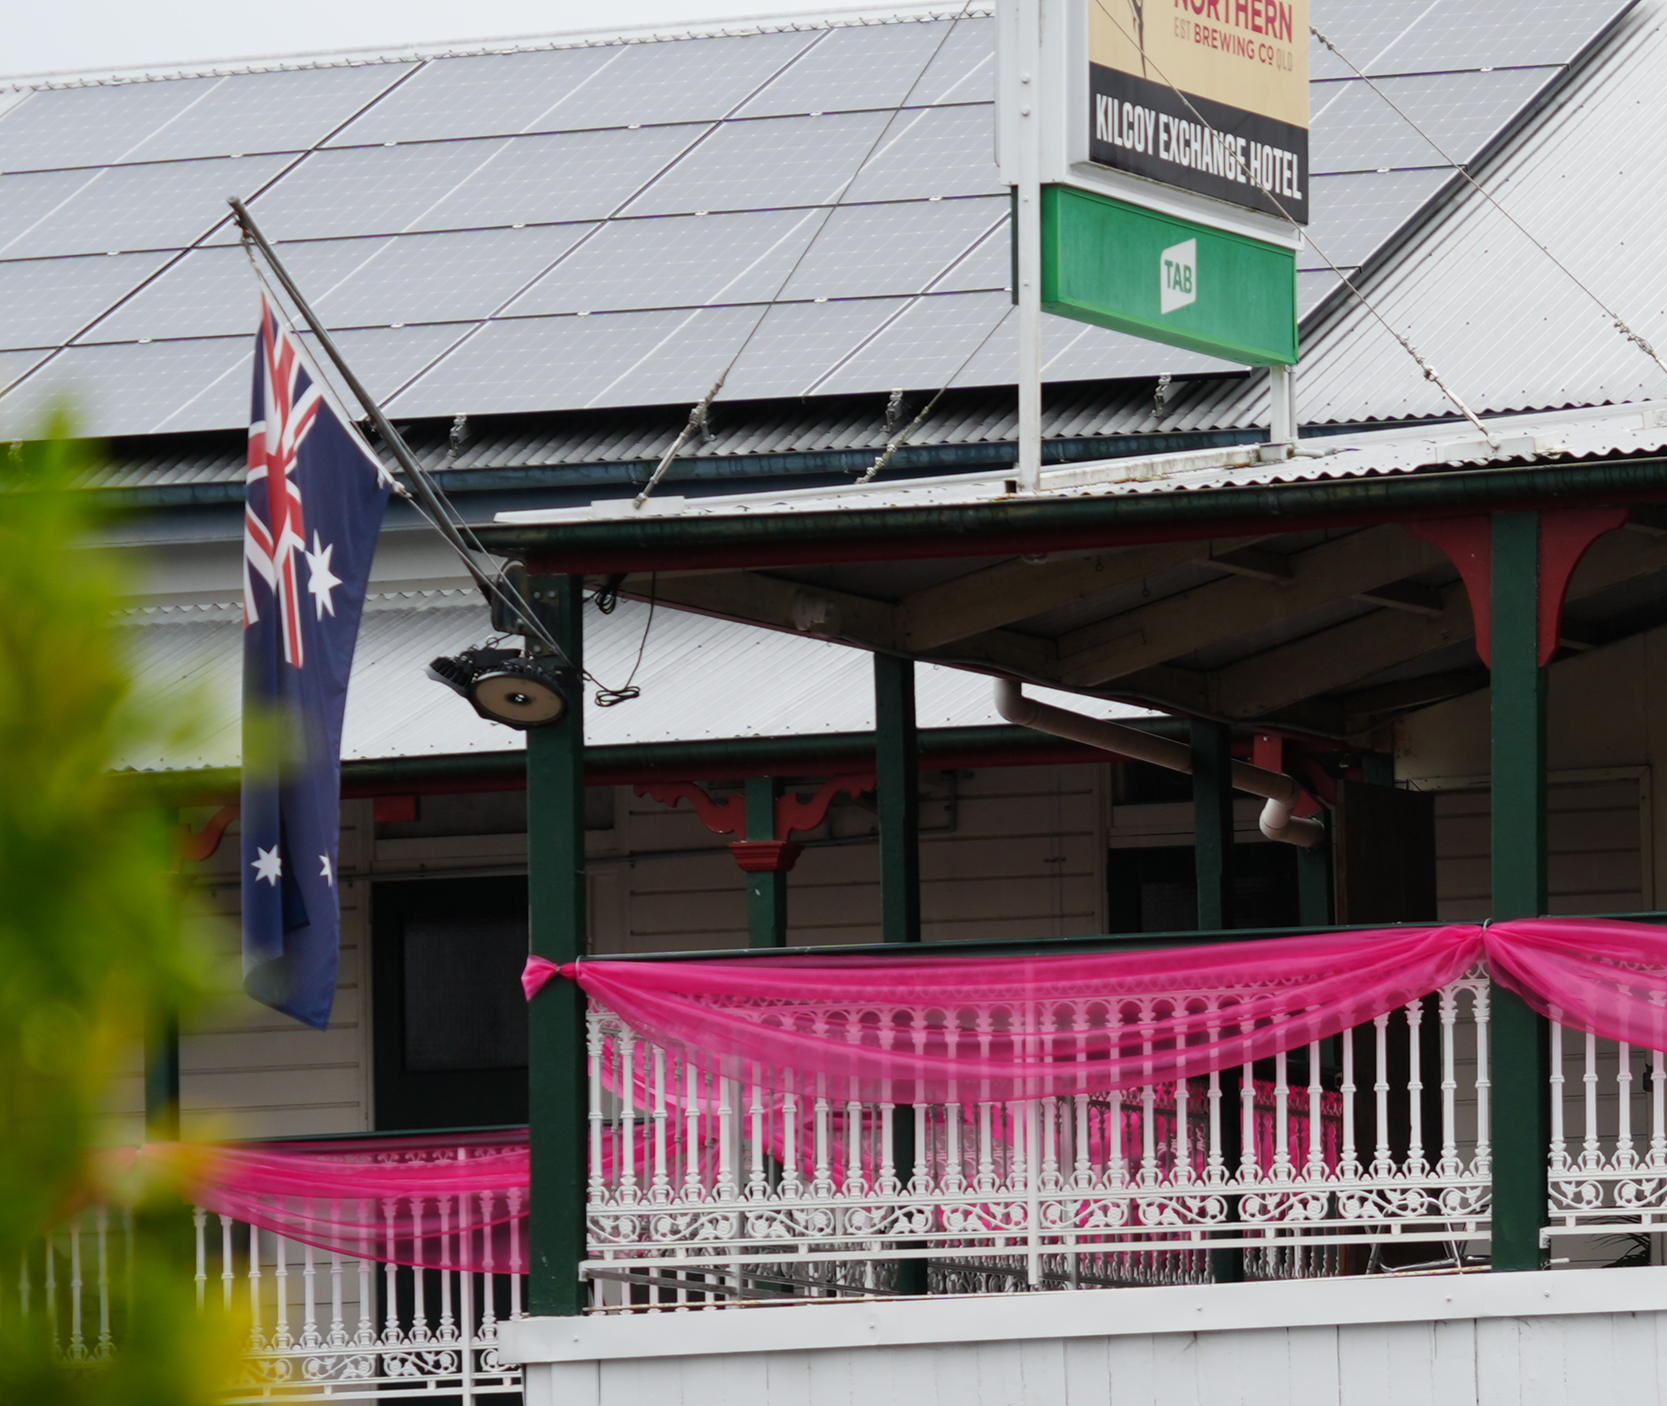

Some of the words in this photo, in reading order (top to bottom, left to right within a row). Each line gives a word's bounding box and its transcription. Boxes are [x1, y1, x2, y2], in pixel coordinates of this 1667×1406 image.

[1194, 22, 1255, 60] BREWING
[1096, 93, 1156, 155] KILCOY
[1159, 112, 1247, 184] EXCHANGE
[1250, 141, 1302, 200] HOTEL
[1164, 259, 1192, 294] TAB
